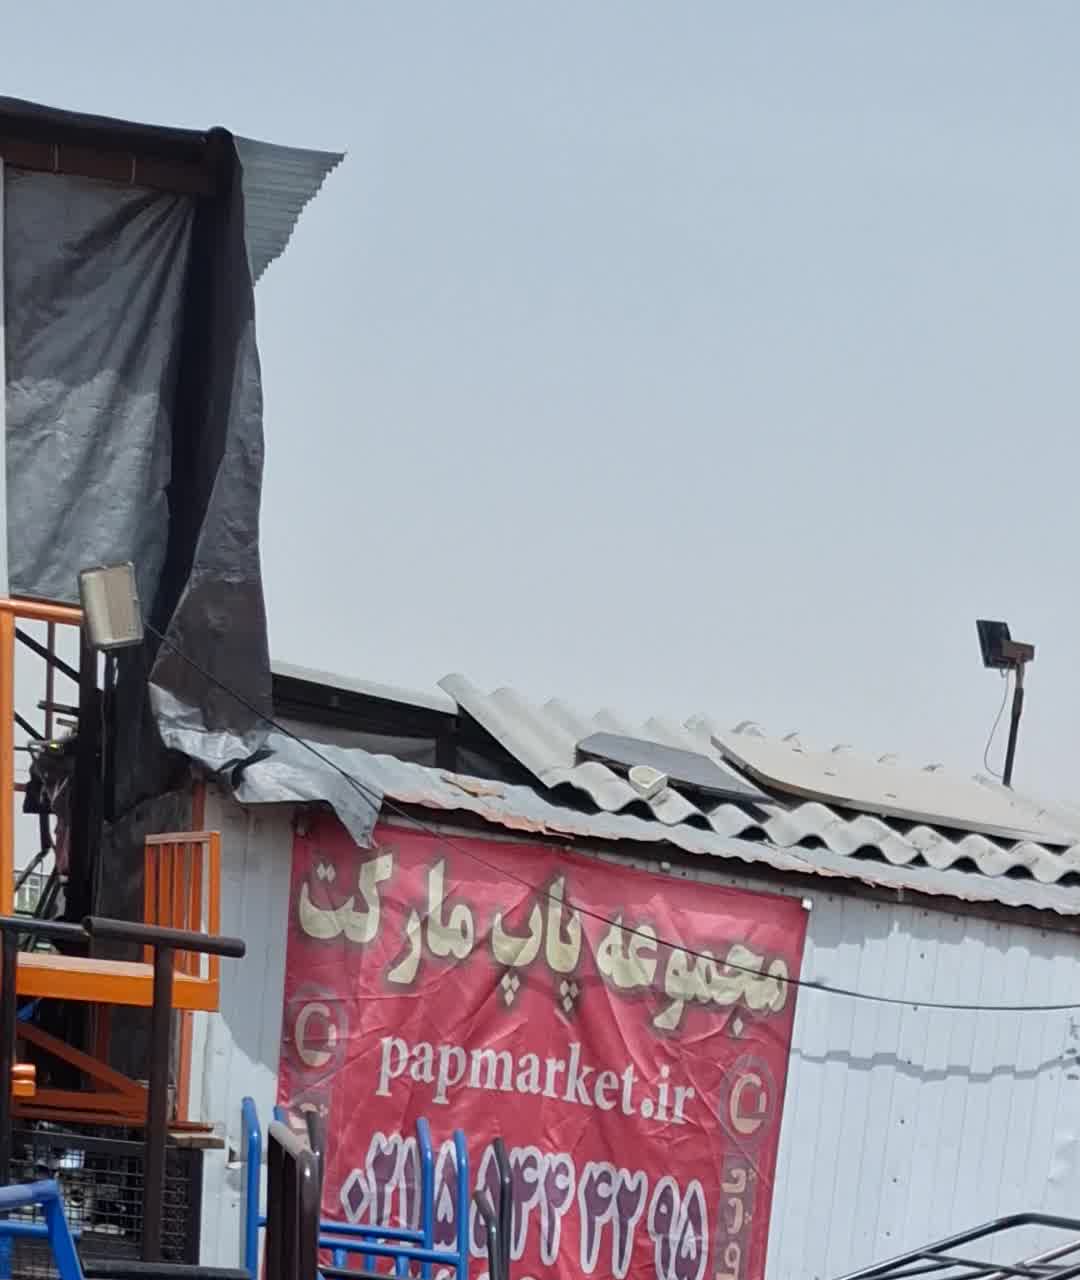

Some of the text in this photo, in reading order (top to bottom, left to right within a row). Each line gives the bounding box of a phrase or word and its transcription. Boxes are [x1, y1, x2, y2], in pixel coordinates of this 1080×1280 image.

[492, 876, 582, 1012] پاپ
[599, 914, 789, 1037] مجموعه
[376, 1035, 695, 1126] papmarket.ir
